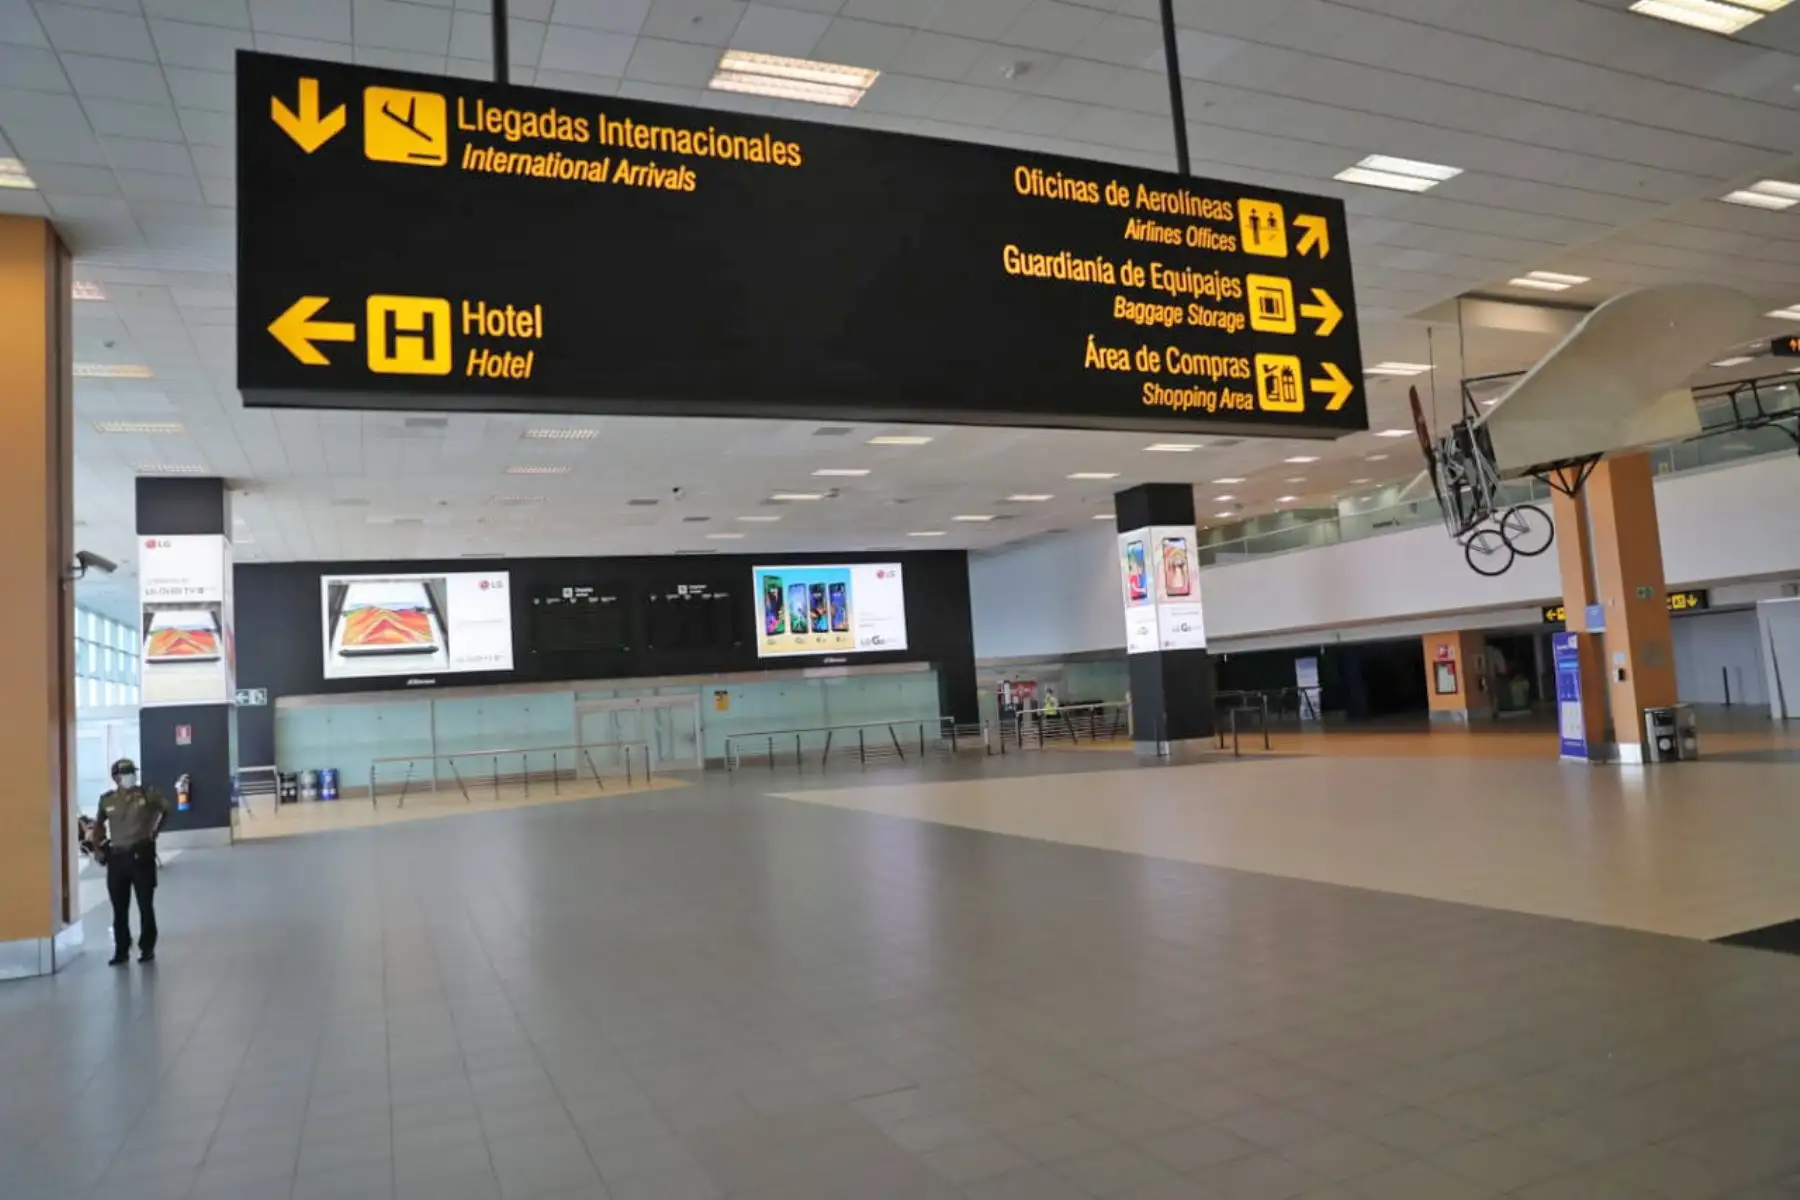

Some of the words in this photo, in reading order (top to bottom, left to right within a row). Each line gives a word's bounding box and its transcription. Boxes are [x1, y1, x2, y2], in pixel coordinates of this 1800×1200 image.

[458, 97, 590, 143] Llegadas
[599, 113, 802, 167] Internacionales
[462, 142, 610, 182] International
[613, 160, 697, 192] Arrivals
[1015, 165, 1100, 204] Oficinas
[1105, 181, 1130, 208] de
[1135, 184, 1234, 222] Aerolíneas
[1124, 218, 1183, 246] Airlines
[1186, 226, 1237, 253] Offices
[1003, 244, 1117, 285] Guardianía
[1120, 259, 1146, 288] de
[1150, 263, 1243, 301] Equipajes
[463, 299, 543, 339] Hotel
[1113, 295, 1184, 328] Baggage
[1188, 304, 1246, 334] Storage
[466, 348, 534, 379] Hotel
[1084, 334, 1132, 372] Área
[1136, 344, 1161, 374] de
[1166, 347, 1251, 382] Compras
[1143, 381, 1217, 413] Shopping
[1220, 388, 1254, 411] Area
